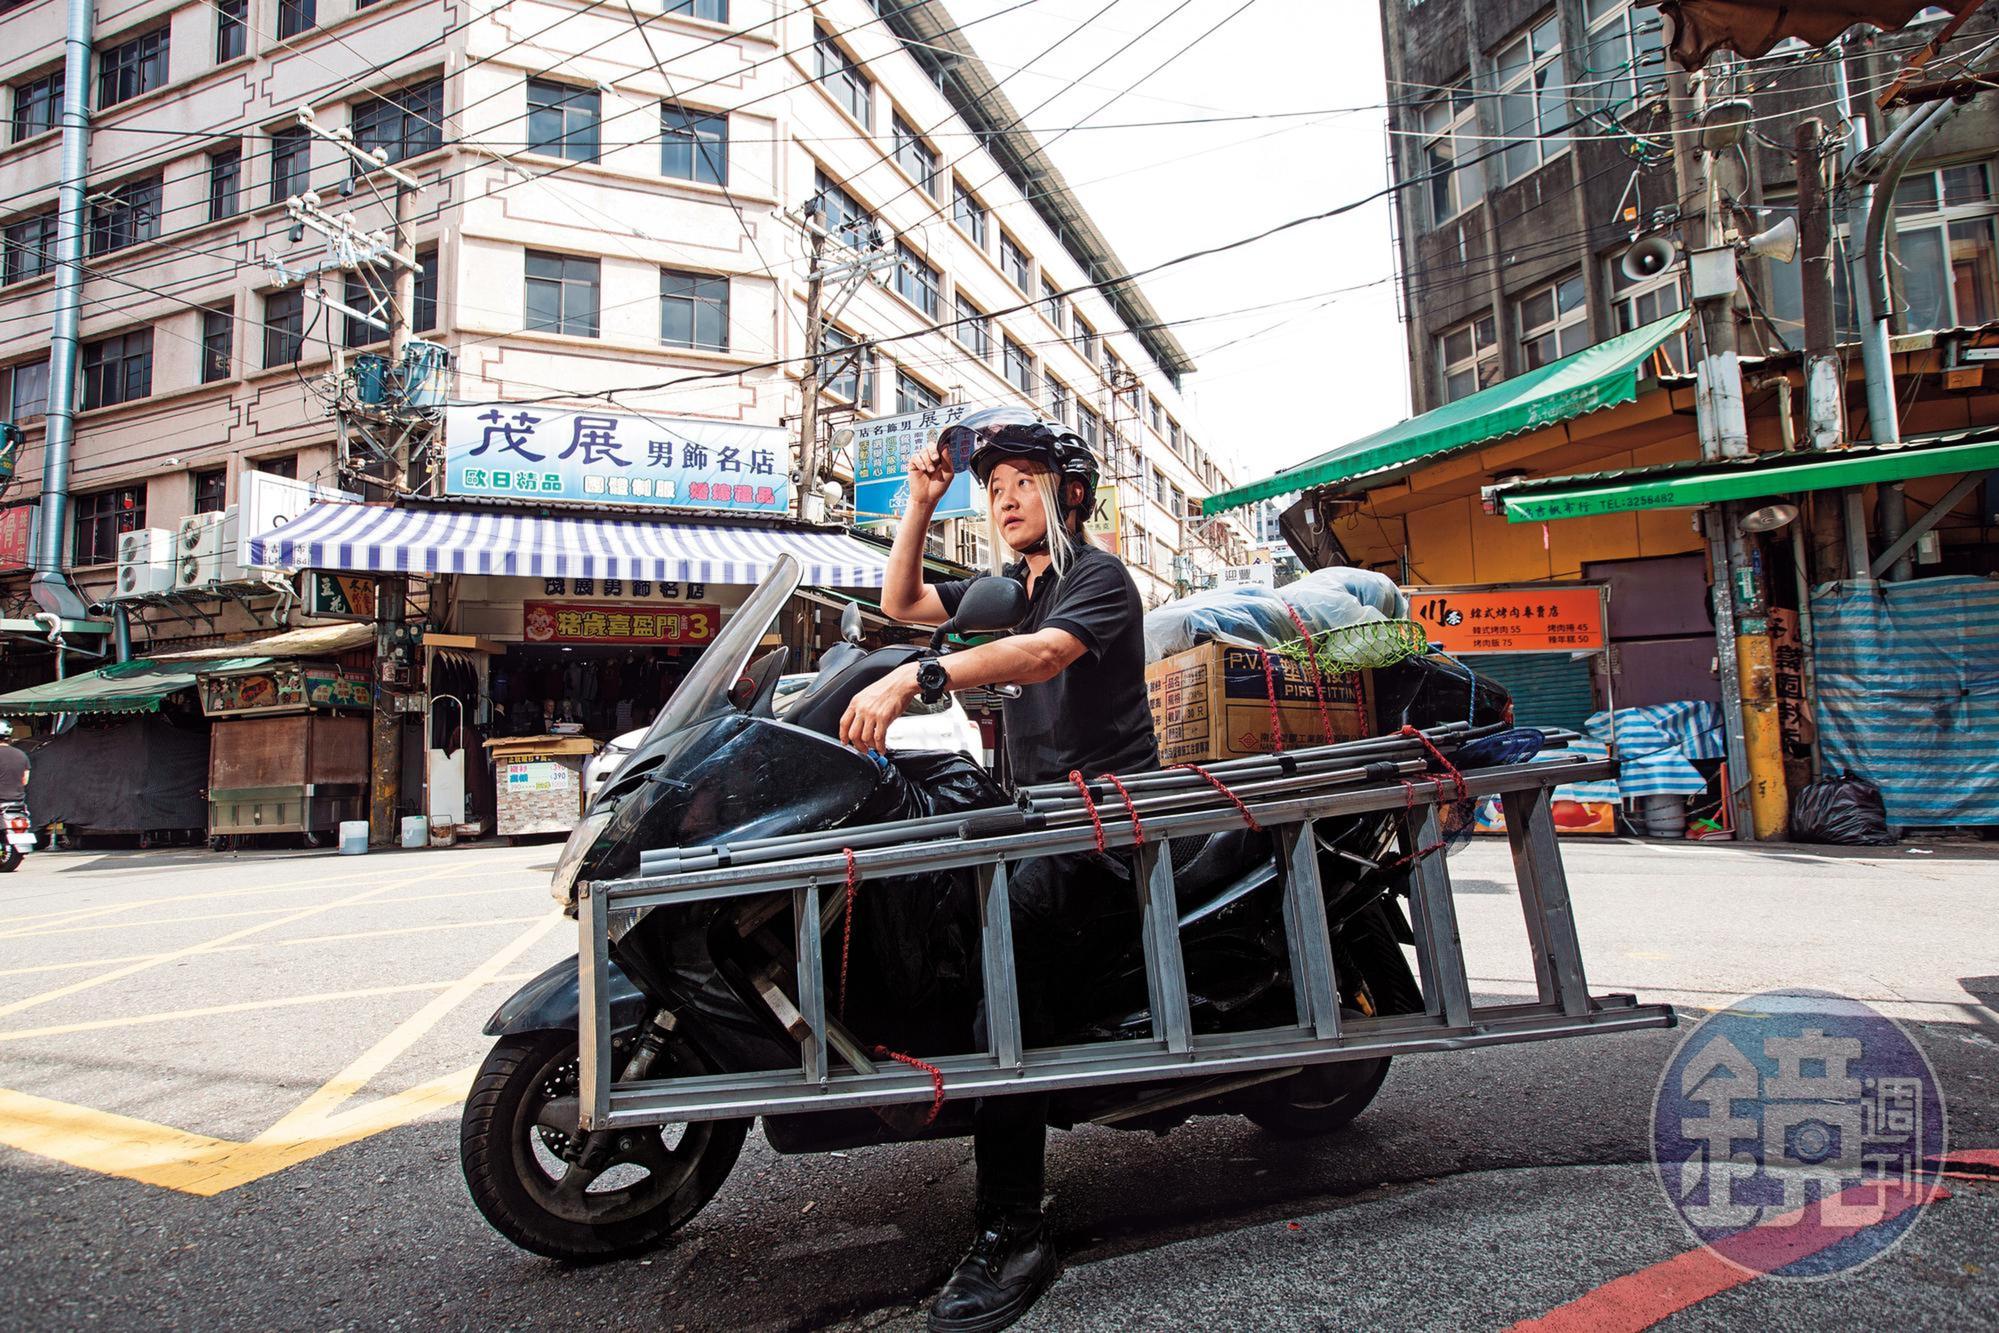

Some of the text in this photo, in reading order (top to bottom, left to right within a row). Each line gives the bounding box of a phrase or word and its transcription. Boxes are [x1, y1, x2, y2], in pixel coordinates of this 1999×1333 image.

[469, 409, 775, 475] 茂展 男飾名店
[465, 469, 563, 491] 歐日精品
[319, 576, 347, 613] 豆花
[688, 613, 709, 639] 3
[1473, 639, 1500, 647] 烤肉飯
[1285, 685, 1315, 697] PIPE
[553, 772, 566, 780] 390
